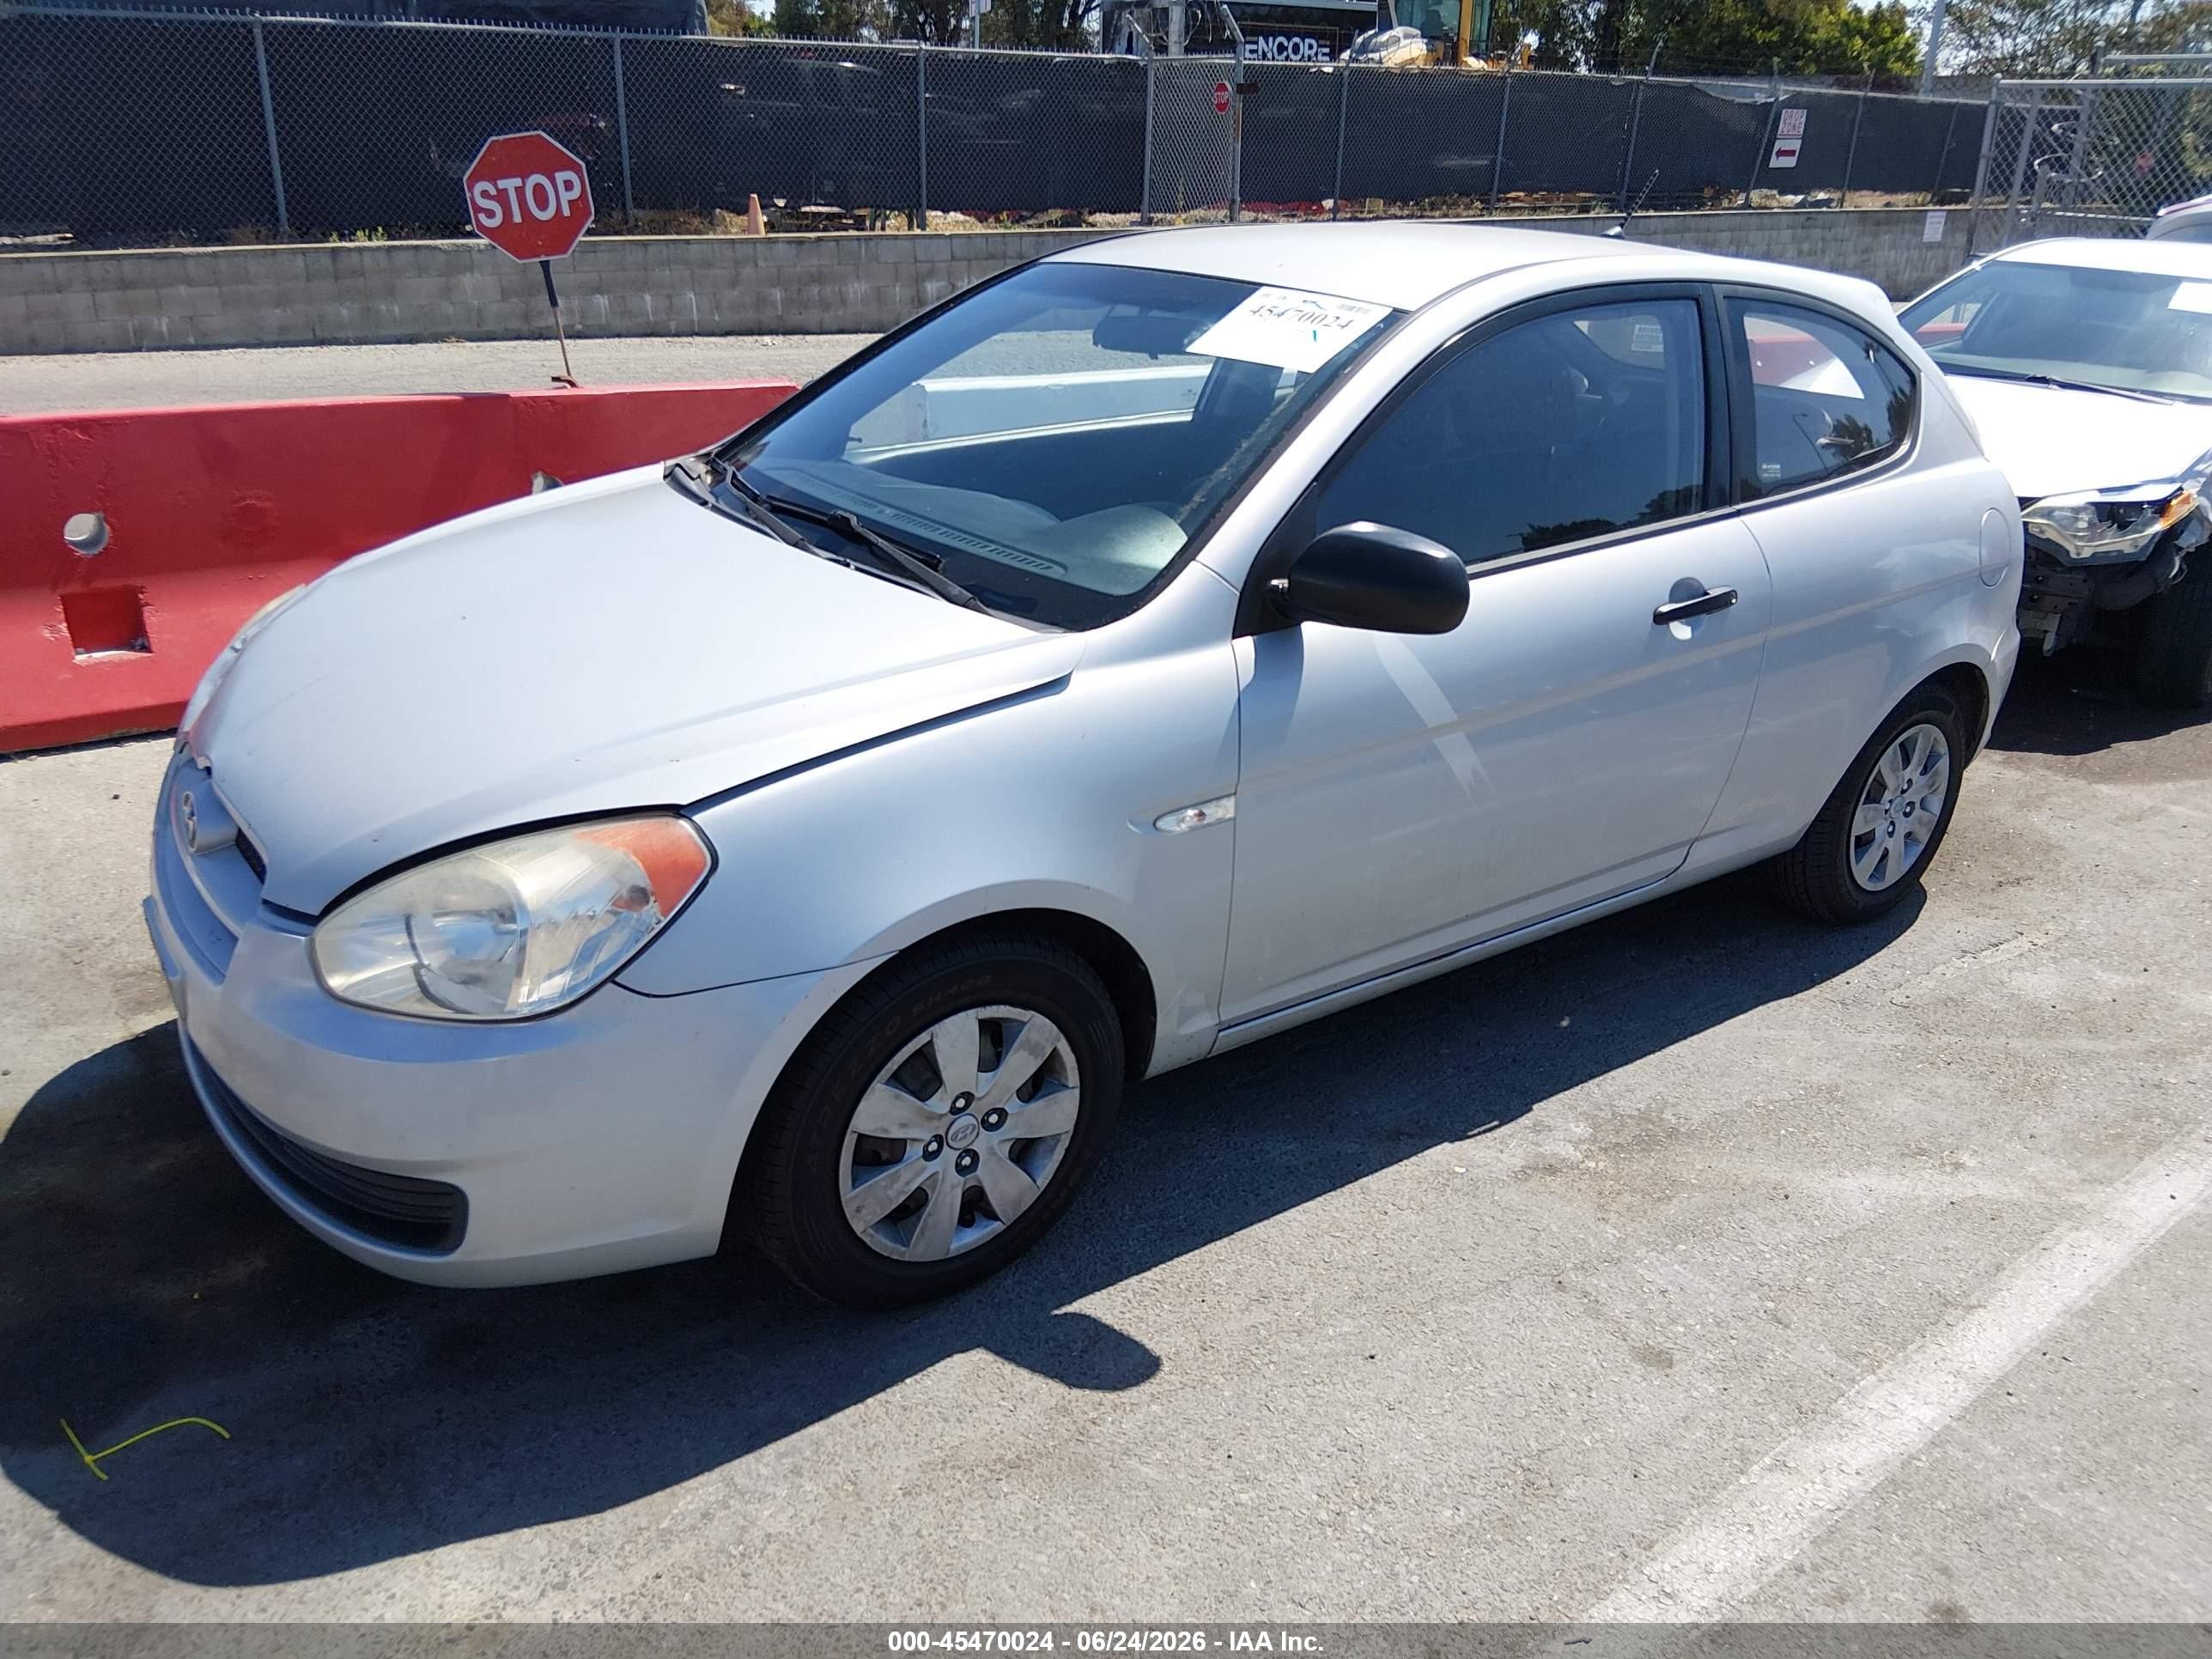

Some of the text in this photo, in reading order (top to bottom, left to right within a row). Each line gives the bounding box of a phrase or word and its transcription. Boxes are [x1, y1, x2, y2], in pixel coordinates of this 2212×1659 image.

[1244, 35, 1330, 62] ENCORE
[1214, 91, 1229, 104] STOP
[1783, 110, 1805, 121] DROP
[1780, 122, 1803, 133] ZONE
[472, 170, 582, 228] STOP
